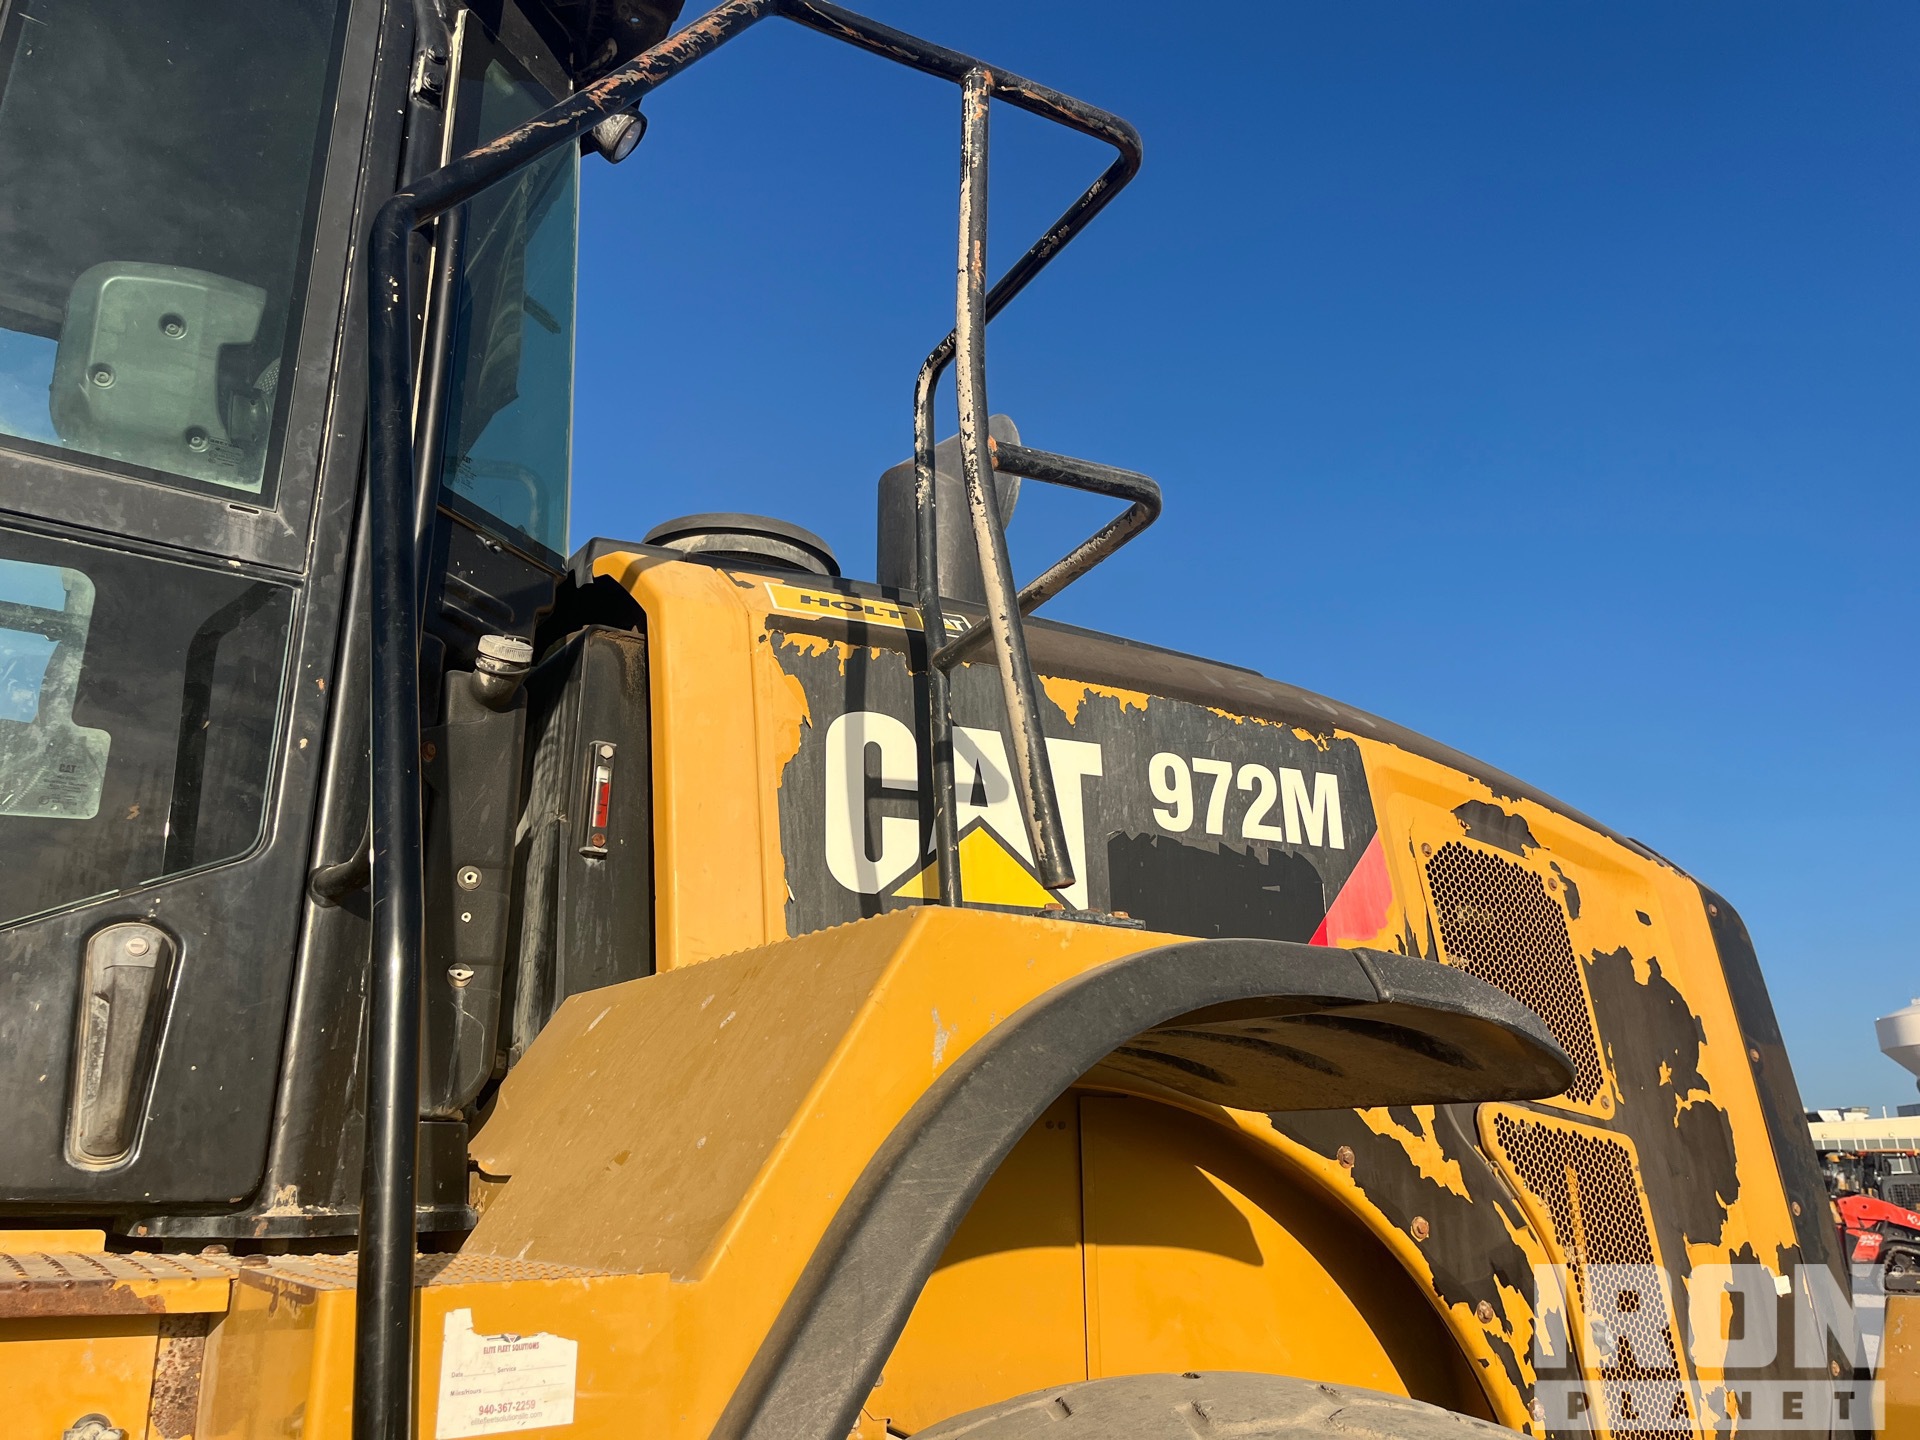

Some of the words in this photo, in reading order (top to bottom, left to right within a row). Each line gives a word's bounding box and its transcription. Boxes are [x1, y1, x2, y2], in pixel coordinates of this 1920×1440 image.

[801, 594, 908, 620] HOLT
[58, 763, 77, 774] CAT
[825, 711, 1102, 910] CAT
[1148, 752, 1345, 850] 972M
[483, 1346, 496, 1355] ELITE
[497, 1344, 511, 1354] FLEET
[512, 1342, 540, 1352] SOLUTIONS
[478, 1399, 536, 1416] 940-367-2259
